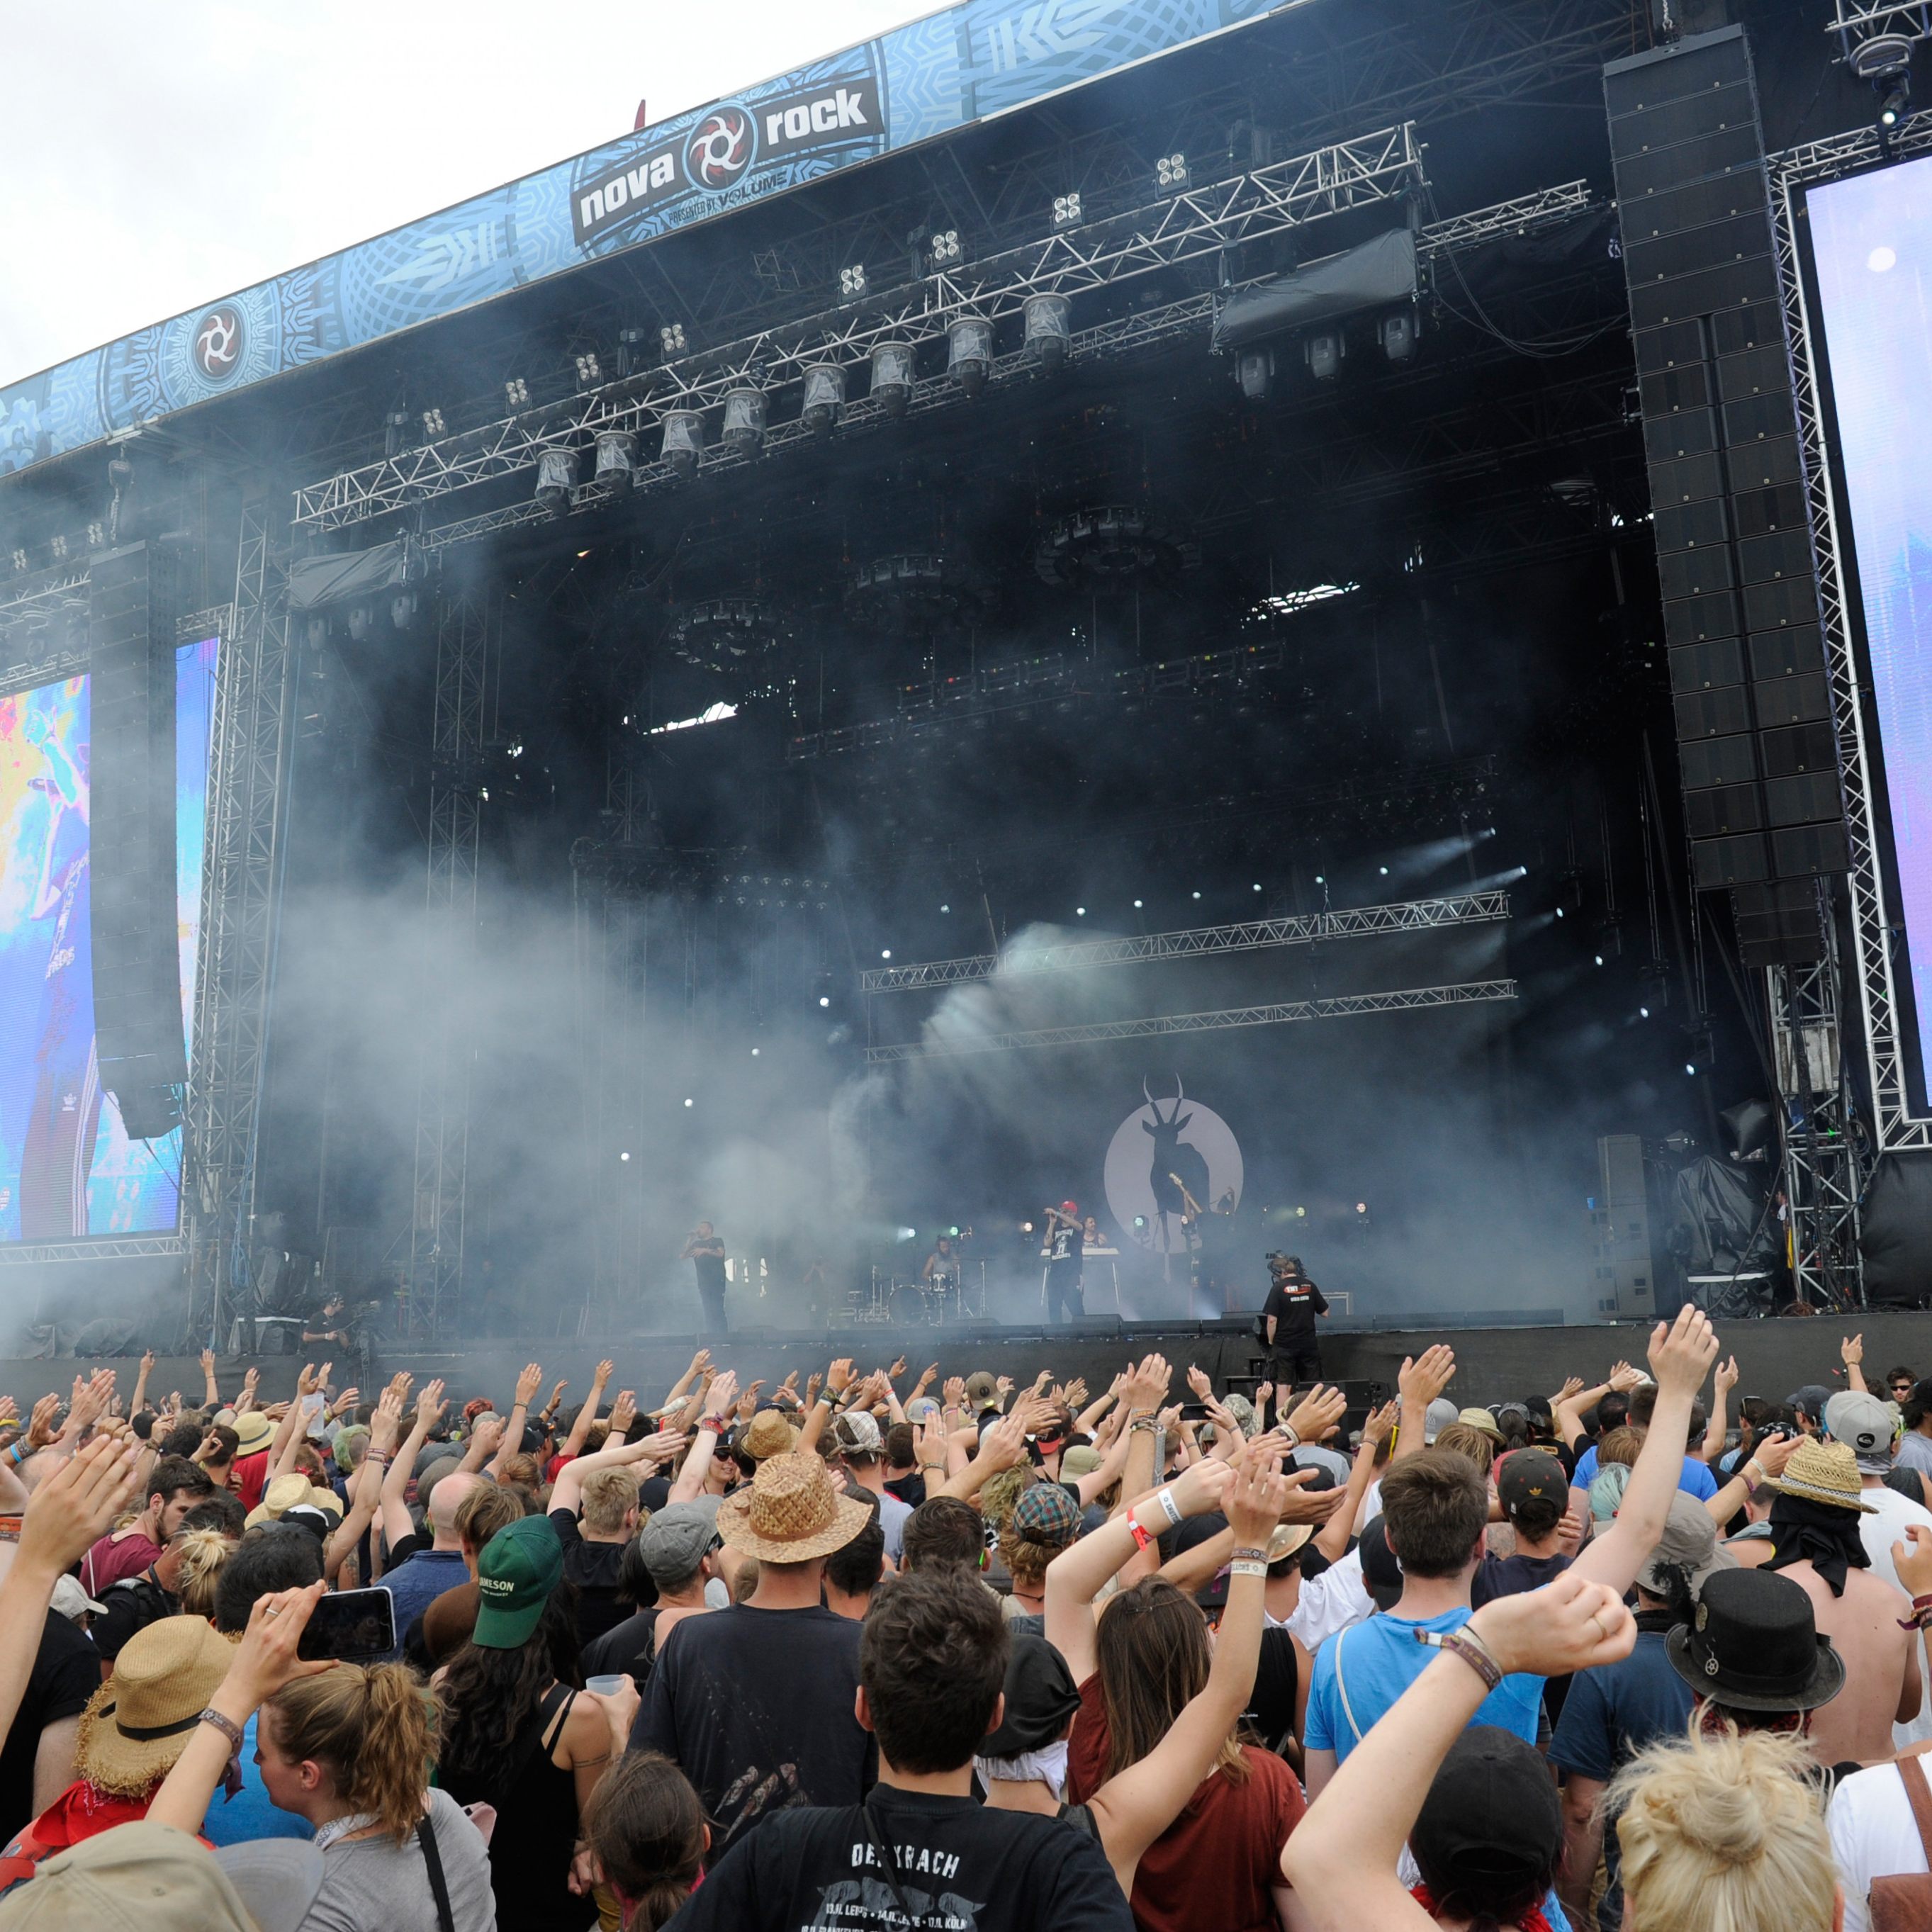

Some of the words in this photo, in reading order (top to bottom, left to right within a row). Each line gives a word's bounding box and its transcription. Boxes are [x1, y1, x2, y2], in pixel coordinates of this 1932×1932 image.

[580, 152, 675, 228] nova
[766, 89, 868, 145] rock
[668, 201, 705, 225] PRESENTED
[706, 198, 715, 212] BY
[718, 172, 787, 206] VOLUME
[479, 1576, 515, 1592] JAMESON
